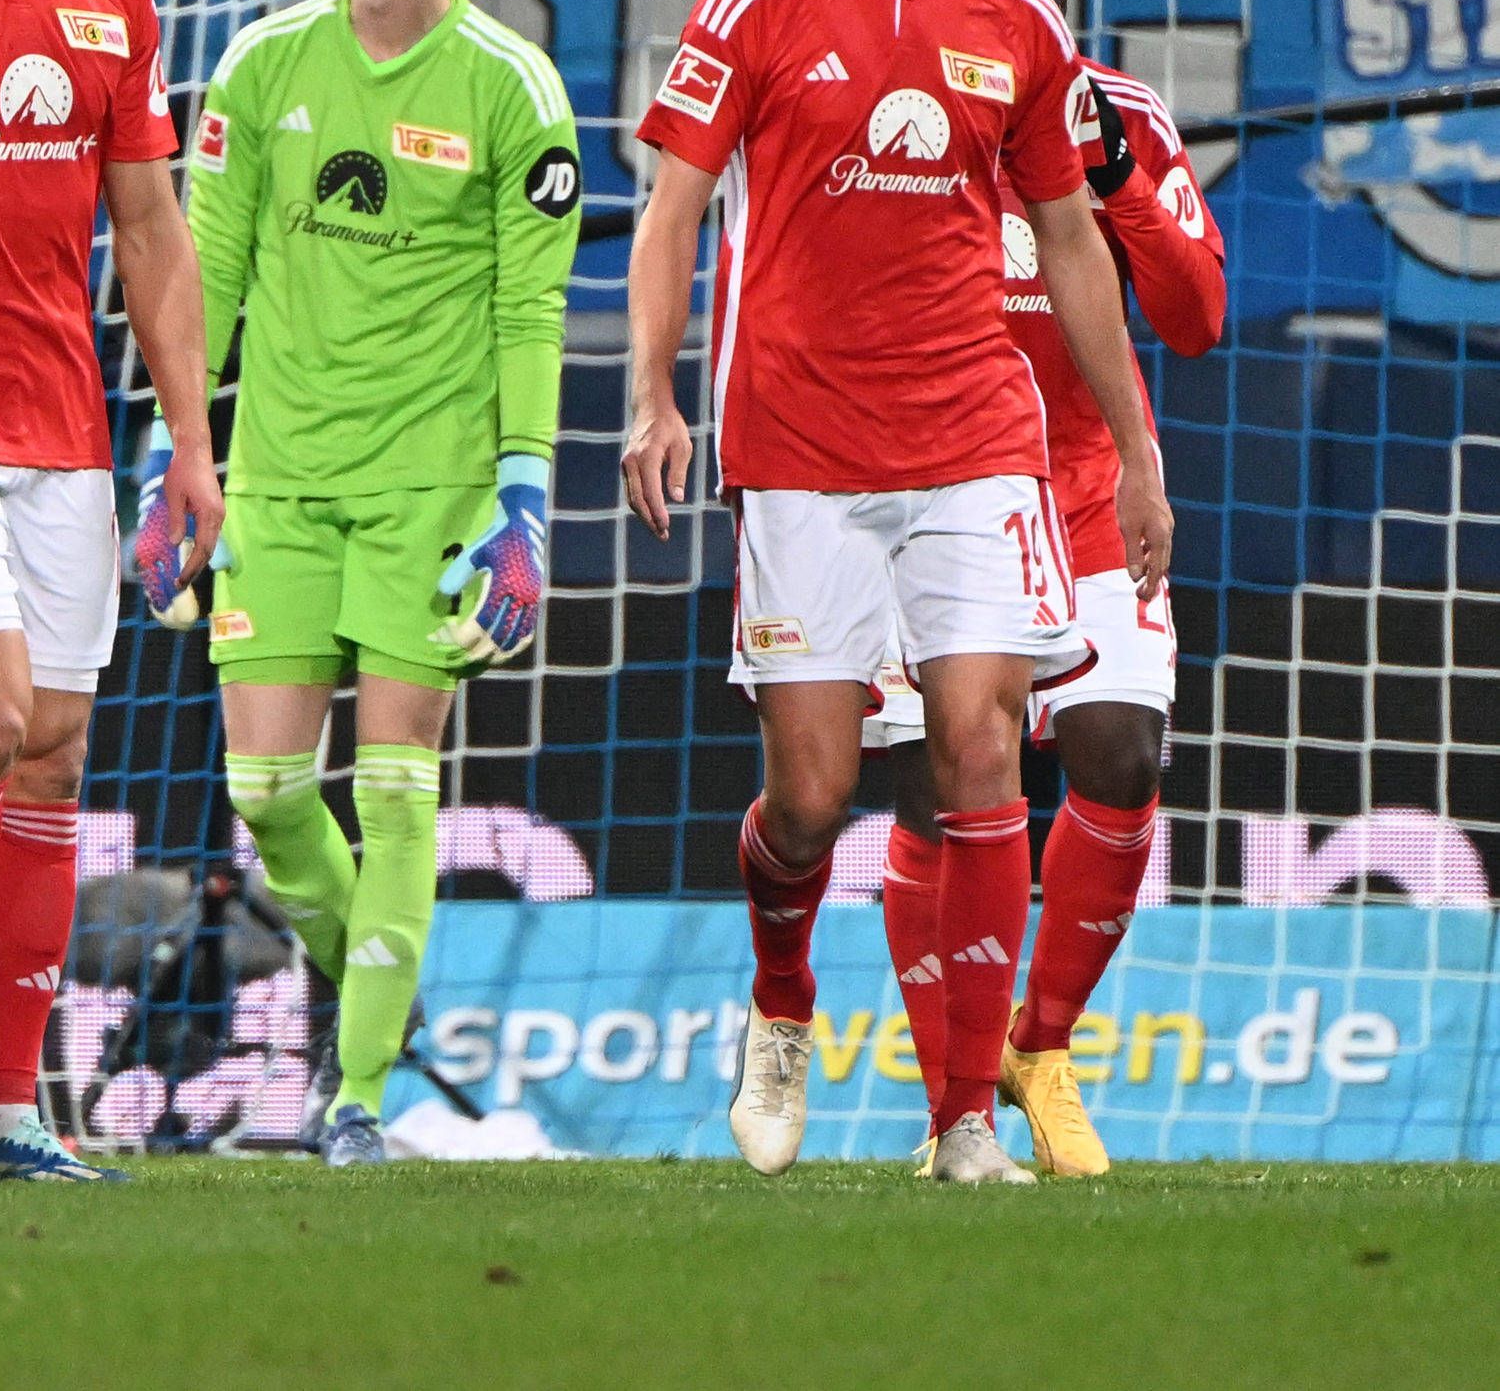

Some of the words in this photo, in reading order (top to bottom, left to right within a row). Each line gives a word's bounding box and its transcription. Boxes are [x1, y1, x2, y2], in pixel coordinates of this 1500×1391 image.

[531, 162, 576, 202] JD
[284, 200, 419, 249] Paramount+
[774, 631, 801, 644] UNION
